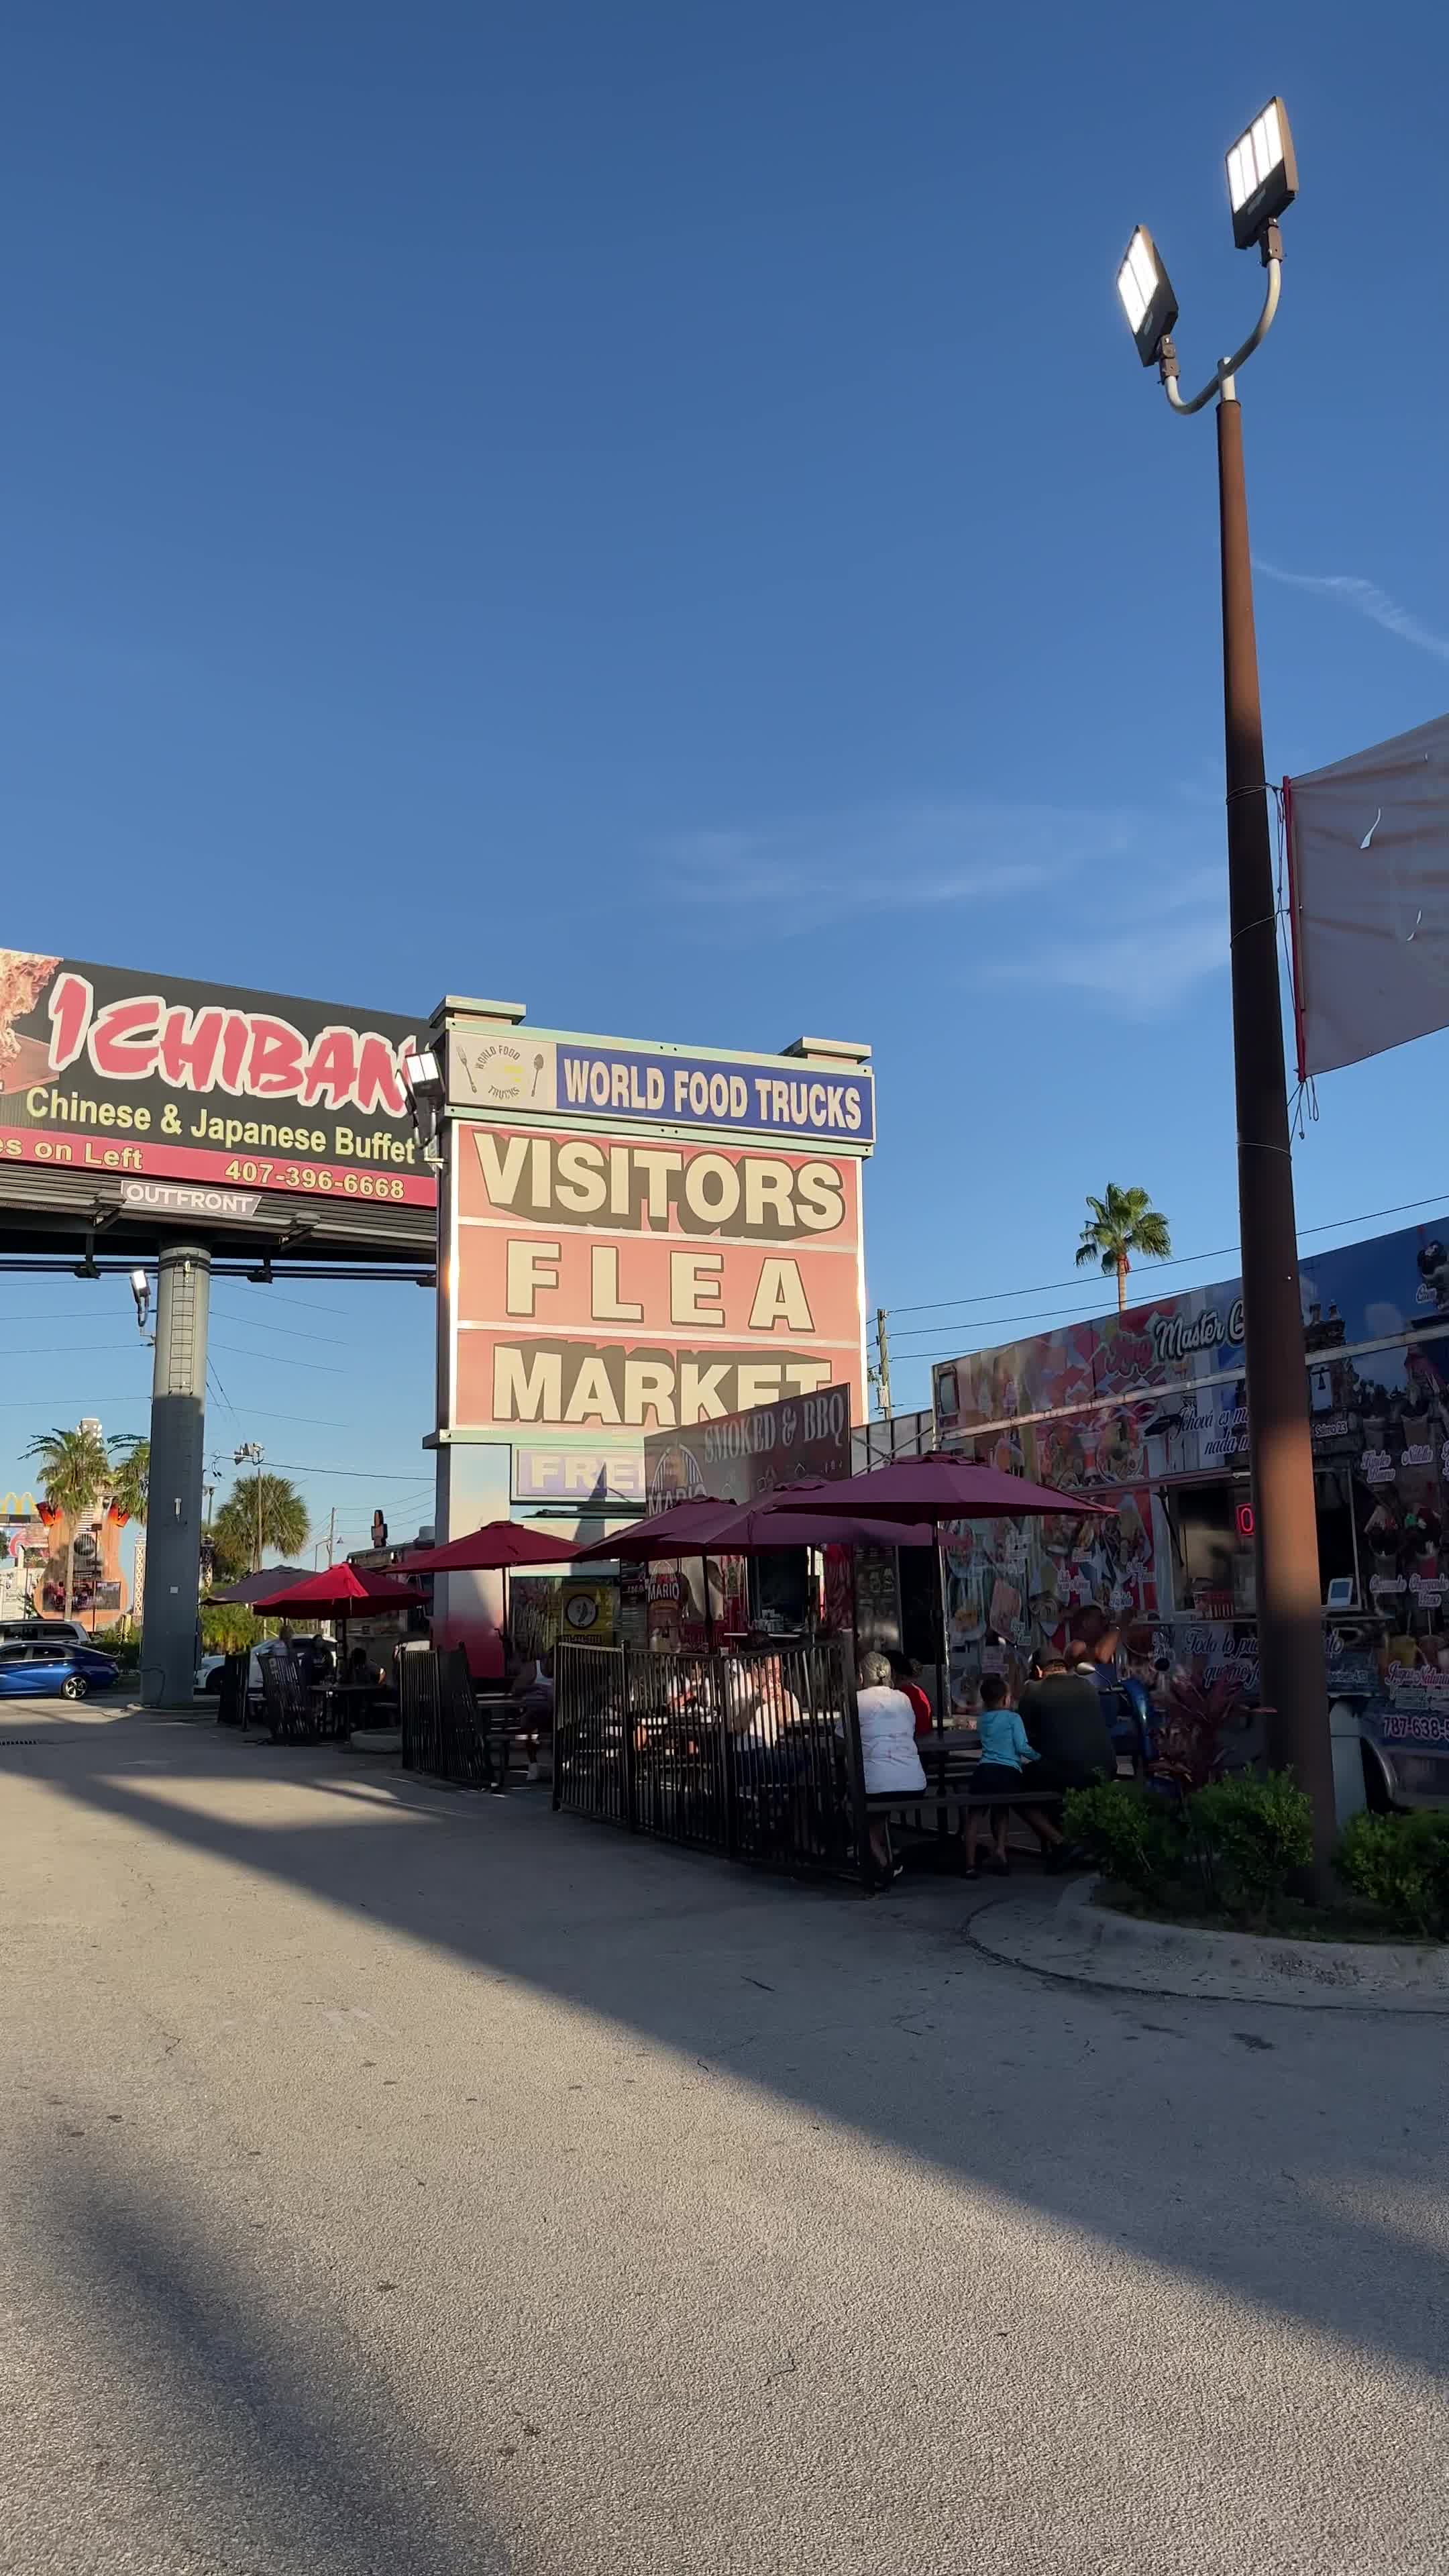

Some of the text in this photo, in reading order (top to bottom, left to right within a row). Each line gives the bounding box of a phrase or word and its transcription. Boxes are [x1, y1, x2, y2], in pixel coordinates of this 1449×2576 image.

[498, 1045, 521, 1061] FOOD
[564, 1059, 862, 1130] WORLD FOOD TRUCKS
[26, 1086, 415, 1165] Chinese & Japanese Buffet
[34, 1141, 72, 1162] on
[85, 1142, 143, 1170] Left
[125, 1183, 254, 1214] OUTFRONT
[225, 1160, 405, 1199] 407-396-6668
[473, 1131, 845, 1234] VISITORS
[1155, 1311, 1225, 1358] Master
[492, 1340, 833, 1428] MARKET
[705, 1393, 845, 1464] SMOKED & BBQ
[648, 1582, 680, 1602] MARIO
